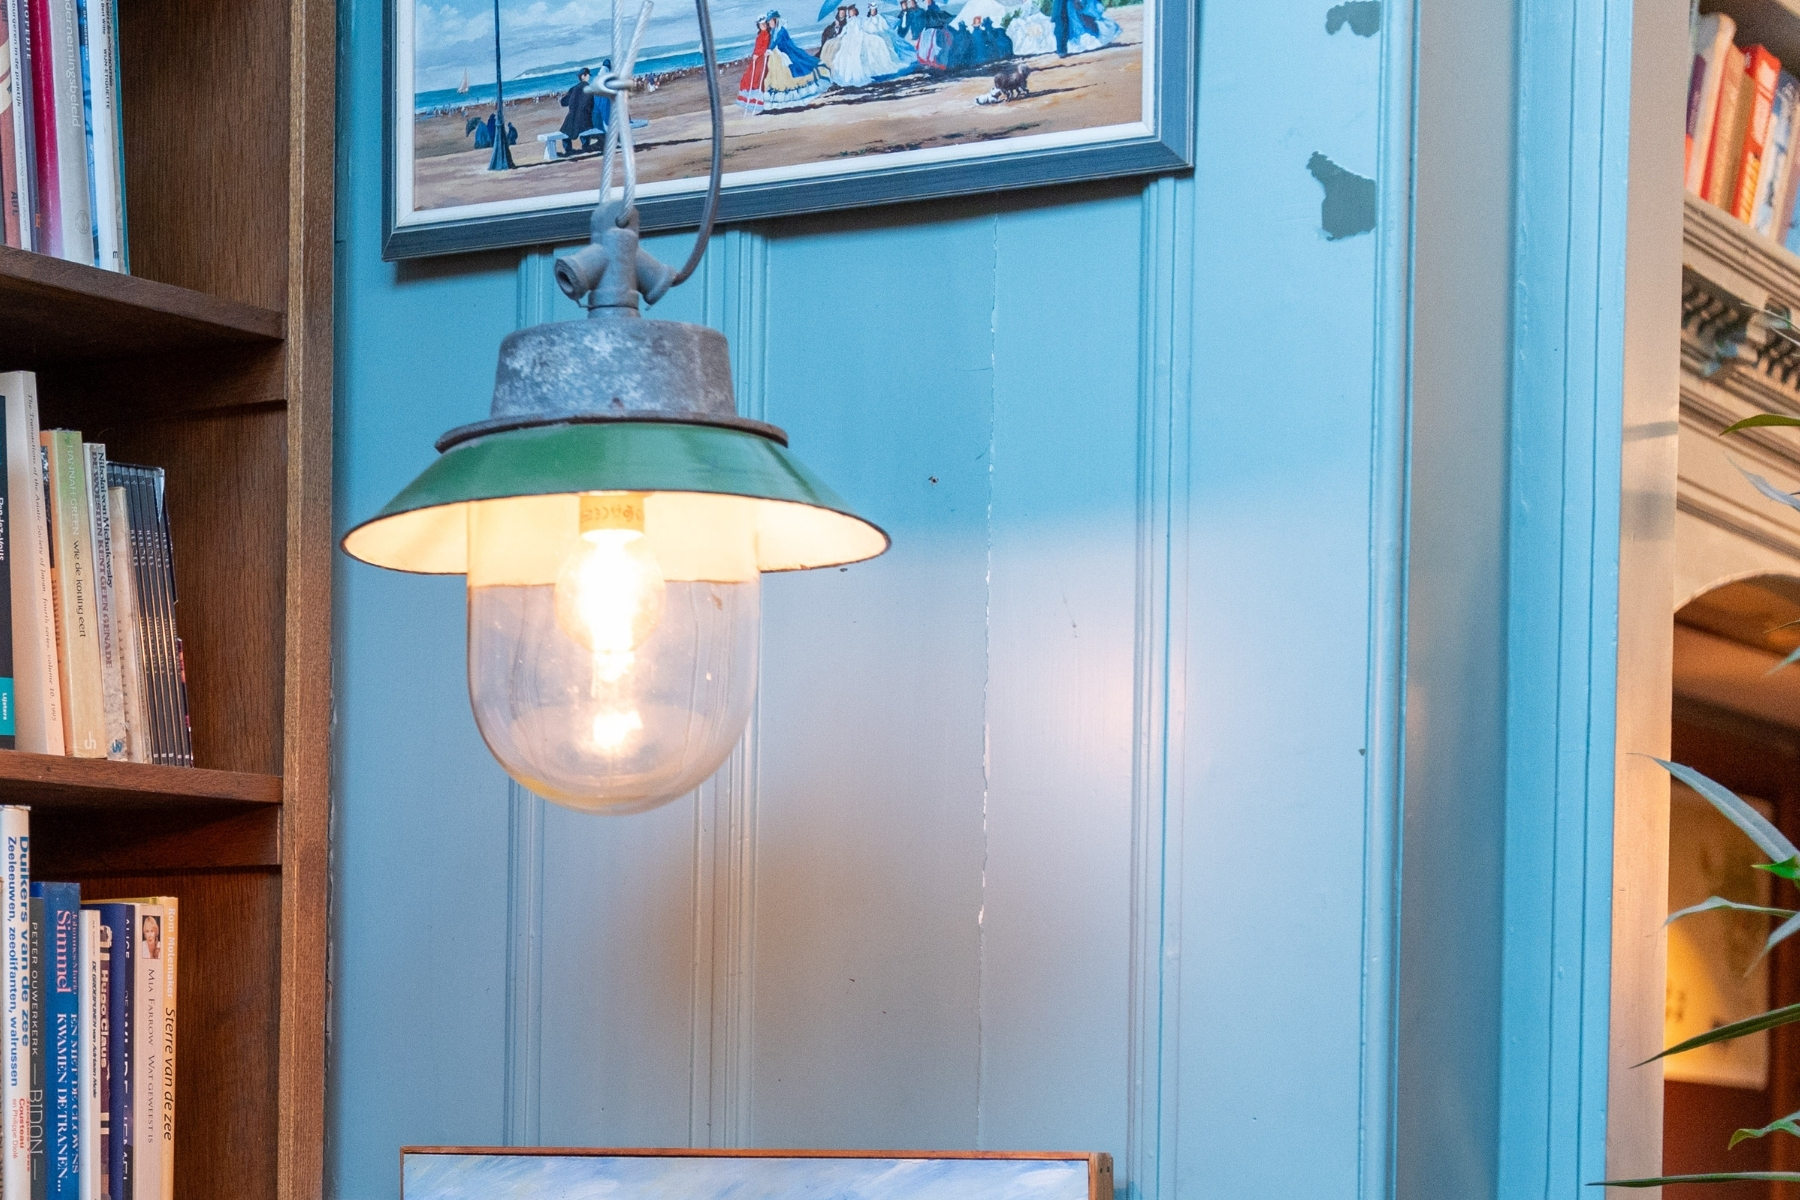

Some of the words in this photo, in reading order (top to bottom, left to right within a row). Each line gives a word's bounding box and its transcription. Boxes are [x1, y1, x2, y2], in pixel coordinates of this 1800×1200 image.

[75, 563, 83, 576] de
[74, 579, 85, 614] koning
[78, 617, 86, 638] eert
[164, 1007, 177, 1053] Sterre
[164, 1058, 174, 1086] van
[164, 1092, 174, 1109] de
[163, 1114, 174, 1140] zee
